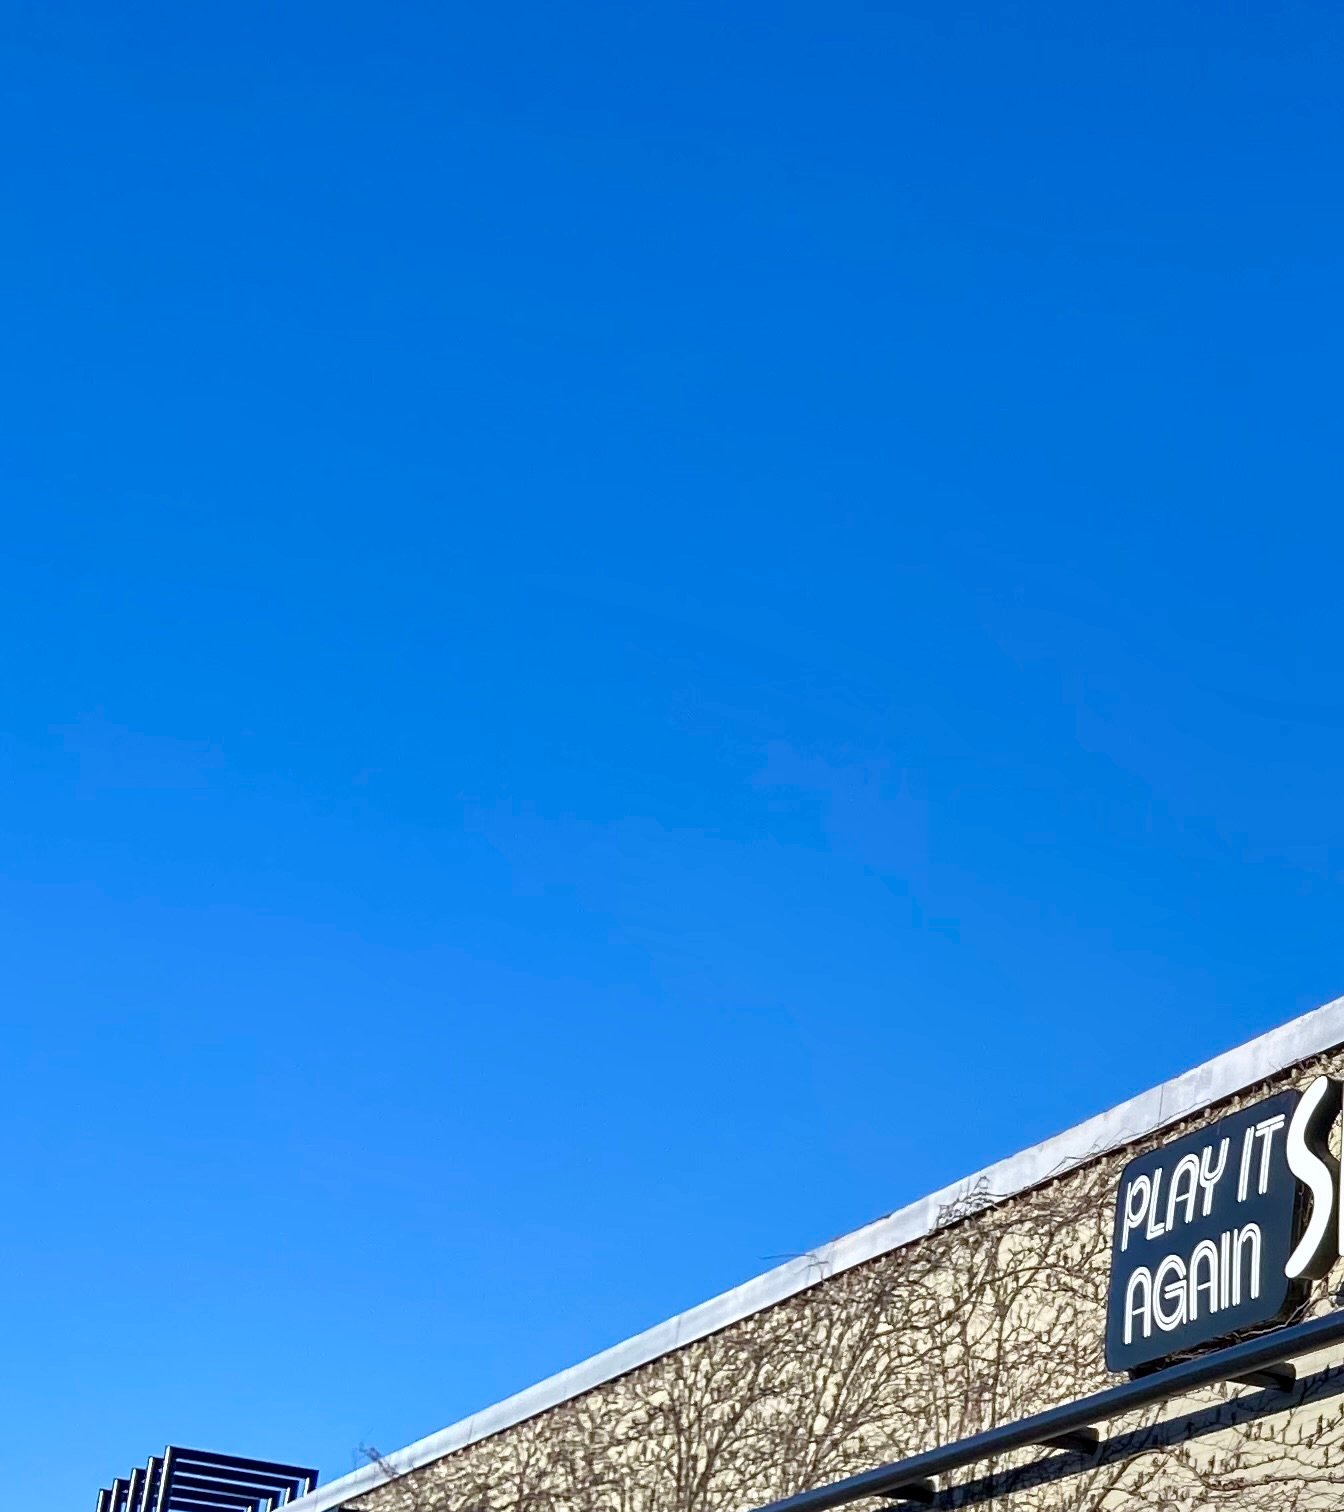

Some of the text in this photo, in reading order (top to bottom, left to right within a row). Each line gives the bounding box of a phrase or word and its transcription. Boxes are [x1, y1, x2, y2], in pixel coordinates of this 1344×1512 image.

[1121, 1112, 1286, 1251] PLAY IT
[1122, 1222, 1262, 1345] AGAIN
